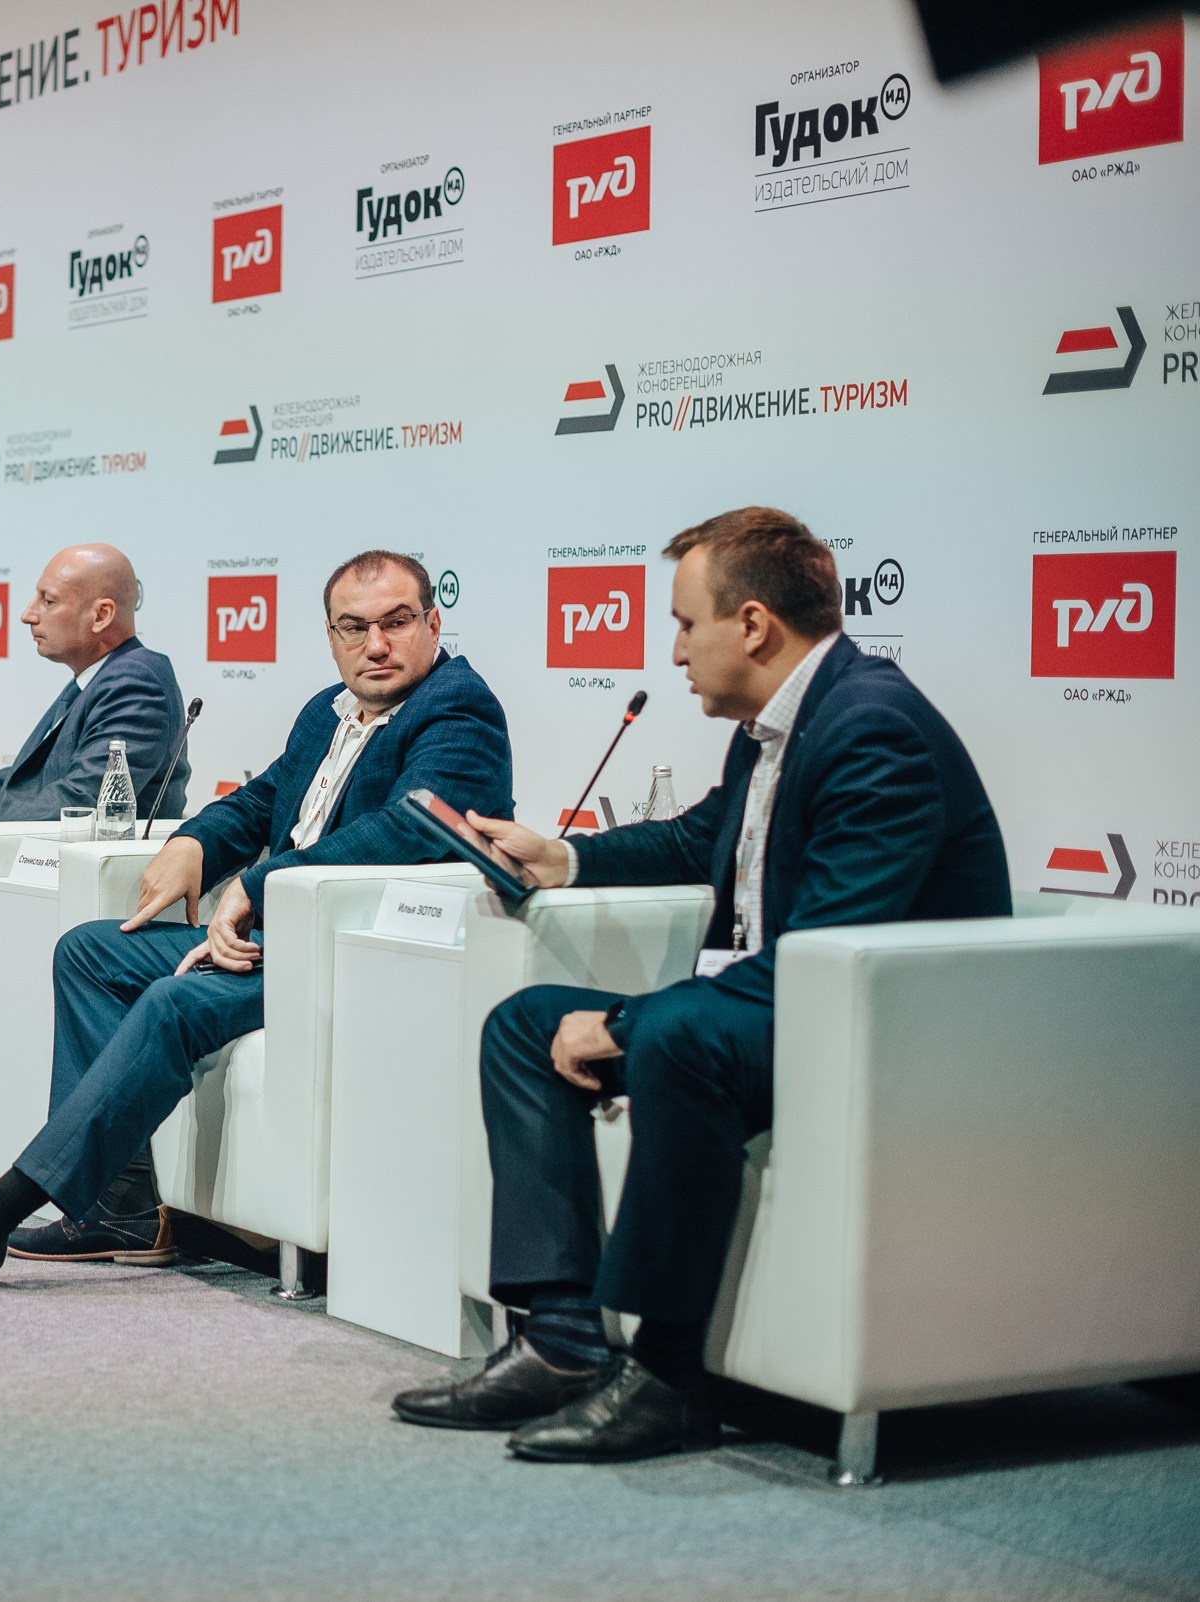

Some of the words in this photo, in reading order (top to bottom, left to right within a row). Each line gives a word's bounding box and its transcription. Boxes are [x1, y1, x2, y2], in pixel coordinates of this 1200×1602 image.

[790, 60, 860, 86] ОРГАНИЗАТОР
[553, 111, 612, 137] ГЕНЕРАЛЬНЫЙ
[613, 105, 652, 125] ПАРТНЕР
[755, 95, 880, 168] Гудок
[380, 154, 430, 174] ОРГАНИЗАТОР
[1072, 166, 1097, 182] ОАО
[1100, 161, 1141, 179] «РЖД»
[356, 186, 443, 242] Гудок
[574, 248, 592, 262] ОАО
[594, 244, 622, 259] «РЖД»
[69, 250, 132, 297] Гудок
[1164, 323, 1200, 342] КОН
[637, 350, 762, 377] ЖЕЛЕЗНОДОРОЖНАЯ
[637, 373, 723, 395] КОНФЕРЕНЦИЯ
[1033, 526, 1118, 544] ГЕНЕРАЛЬНЫЙ
[1122, 526, 1178, 541] ПАРТНЕР
[548, 543, 607, 558] ГЕНЕРАЛЬНЫЙ
[608, 544, 647, 557] ПАРТНЕР
[568, 677, 586, 688] ОАО
[588, 677, 616, 690] «РЖД»
[1063, 688, 1089, 701] ОАО
[1092, 688, 1132, 705] «РЖД»
[44, 858, 60, 869] АРИС
[397, 902, 417, 915] Илья
[417, 904, 443, 918] ЗОТОВ
